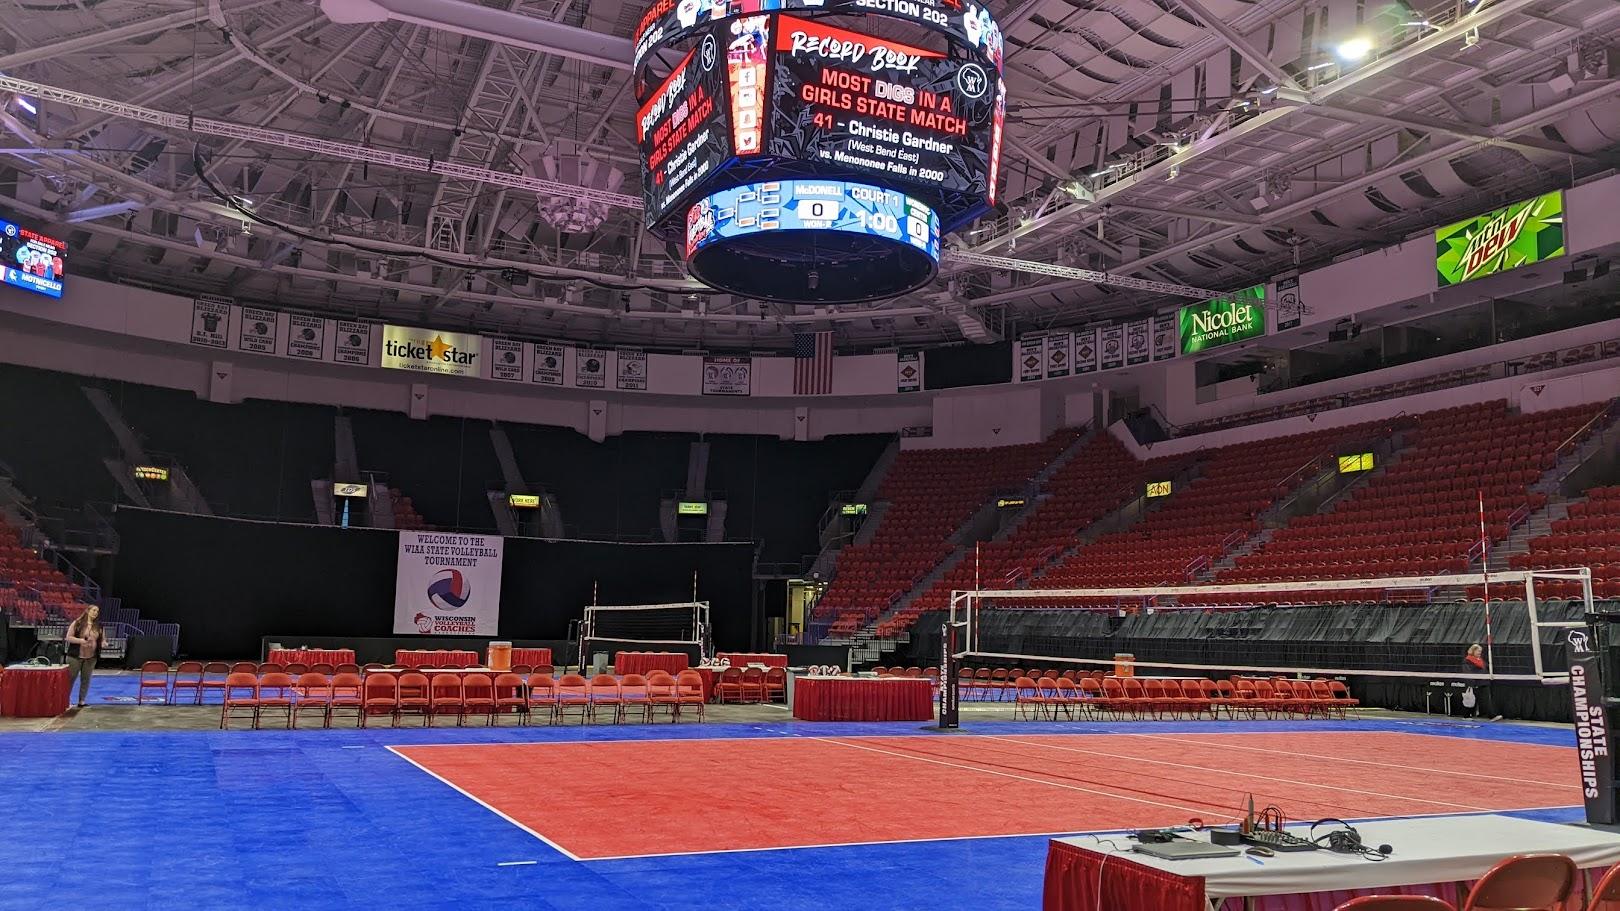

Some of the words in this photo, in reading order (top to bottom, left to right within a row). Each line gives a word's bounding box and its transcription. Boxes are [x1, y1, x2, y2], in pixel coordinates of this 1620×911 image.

[923, 7, 948, 27] 202
[791, 31, 865, 63] RECORD
[868, 46, 920, 74] BOOK
[822, 69, 871, 93] MOST
[875, 80, 915, 104] DIGS
[919, 90, 936, 108] IN
[939, 97, 952, 112] A
[654, 118, 672, 147] MOST
[688, 92, 697, 111] IN
[697, 85, 704, 103] A
[802, 85, 852, 110] GIRLS
[857, 97, 906, 121] STATE
[910, 109, 967, 135] MATCH
[650, 143, 667, 170] GIRLS
[668, 123, 687, 152] STATE
[687, 97, 713, 133] MATCH
[813, 112, 833, 129] 41
[849, 120, 900, 144] Christie
[902, 131, 954, 155] Gardner
[848, 139, 875, 155] (West
[875, 145, 898, 159] Bend
[897, 148, 920, 165] East)
[655, 170, 664, 185] 41
[667, 149, 688, 175] Christie
[820, 149, 832, 160] vs.
[887, 162, 908, 175] Falls
[909, 166, 918, 177] in
[919, 168, 944, 182] 2000
[795, 185, 842, 197] McDONELL
[851, 187, 891, 206] COURT
[892, 195, 899, 207] 1
[812, 203, 824, 217] 0
[856, 211, 898, 233] 1:00
[915, 222, 922, 236] 0
[1191, 303, 1253, 336] Nicolet
[1191, 329, 1229, 343] NATIONAL
[1231, 321, 1253, 334] BANK
[385, 340, 432, 360] ticket
[443, 347, 476, 364] star
[1151, 483, 1169, 495] AON
[404, 545, 425, 554] WIAA
[426, 546, 450, 555] STATE
[451, 547, 498, 558] VOLLEYBALL
[418, 535, 457, 545] WELCOME
[459, 537, 468, 545] TO
[471, 538, 485, 546] THE
[425, 556, 477, 567] TOURNAMENT
[1571, 665, 1598, 799] CHAMPIONSHIPS
[1590, 706, 1608, 756] STATE
